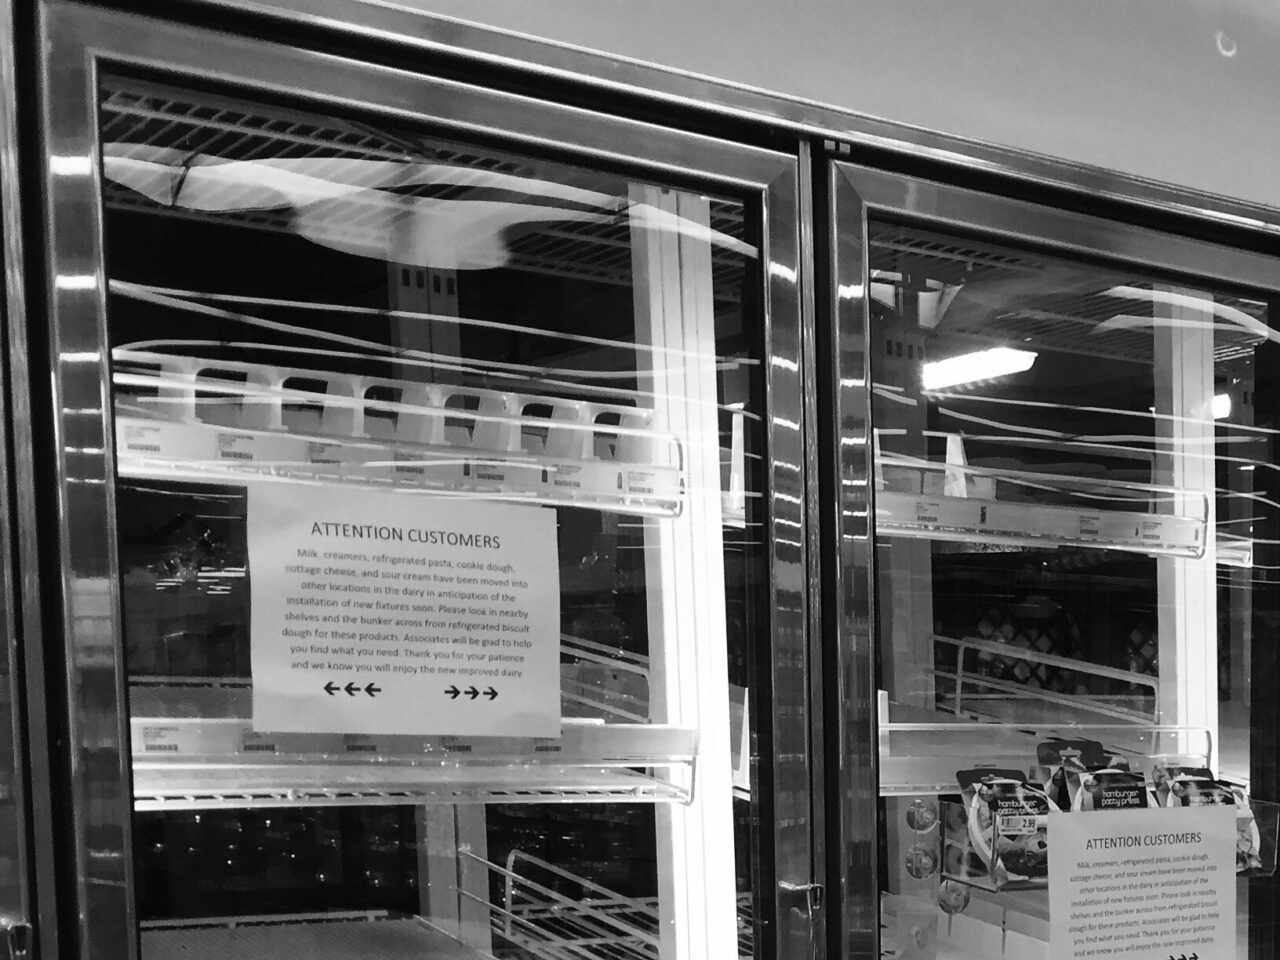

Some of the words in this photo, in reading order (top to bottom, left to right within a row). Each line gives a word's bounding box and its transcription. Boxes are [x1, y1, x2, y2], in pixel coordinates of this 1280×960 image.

[311, 521, 402, 542] ATTENTION
[406, 527, 500, 548] CUSTOMERS
[371, 552, 426, 568] refrigerated
[456, 558, 484, 570] cookie
[285, 563, 321, 576] cottage
[360, 567, 379, 578] and
[380, 571, 401, 579] sour
[402, 572, 431, 581] cream
[432, 572, 454, 583] have
[456, 573, 478, 585] been
[480, 575, 509, 587] moved
[511, 578, 528, 588] into
[301, 579, 326, 590] other
[328, 580, 371, 593] locations
[373, 584, 382, 594] in
[384, 584, 399, 595] the
[401, 585, 424, 599] dairy
[426, 587, 435, 597] in
[437, 588, 488, 603] anticipation
[490, 591, 499, 601] of
[501, 592, 515, 602] the
[286, 594, 338, 607] installation
[340, 597, 351, 607] of
[353, 600, 373, 609] new
[375, 599, 409, 611] fixtures
[438, 603, 466, 614] Please
[468, 605, 486, 616] look
[488, 606, 496, 616] in
[498, 607, 528, 620] nearby
[284, 610, 319, 622] shelves
[321, 612, 339, 623] and
[341, 613, 357, 624] the
[359, 614, 392, 625] bunker
[394, 618, 422, 627] across
[424, 617, 446, 628] from
[448, 618, 500, 633] refrigerated
[502, 621, 529, 633] biscuit
[282, 626, 312, 639] dough
[314, 628, 328, 638] for
[330, 628, 356, 639] these
[403, 632, 449, 644] Associates
[451, 634, 466, 644] will
[468, 635, 479, 645] be
[481, 635, 500, 648] glad
[502, 638, 511, 647] to
[513, 637, 532, 650] help
[290, 645, 308, 655] you
[310, 643, 329, 654] find
[330, 644, 354, 655] what
[356, 648, 373, 658] you
[403, 647, 431, 658] Thank
[433, 651, 449, 661] you
[451, 649, 463, 659] for
[465, 652, 486, 663] your
[487, 651, 525, 665] patience
[290, 658, 308, 669] and
[327, 660, 353, 670] know
[355, 663, 372, 673] you
[374, 661, 390, 672] will
[392, 665, 417, 675] enjoy
[419, 663, 435, 673] the
[437, 666, 456, 674] new
[458, 665, 499, 678] improved
[1102, 789, 1139, 800] hamburger
[1022, 819, 1036, 828] 2.99
[1086, 834, 1141, 849] ATTENTION
[1143, 831, 1202, 846] CUSTOMERS
